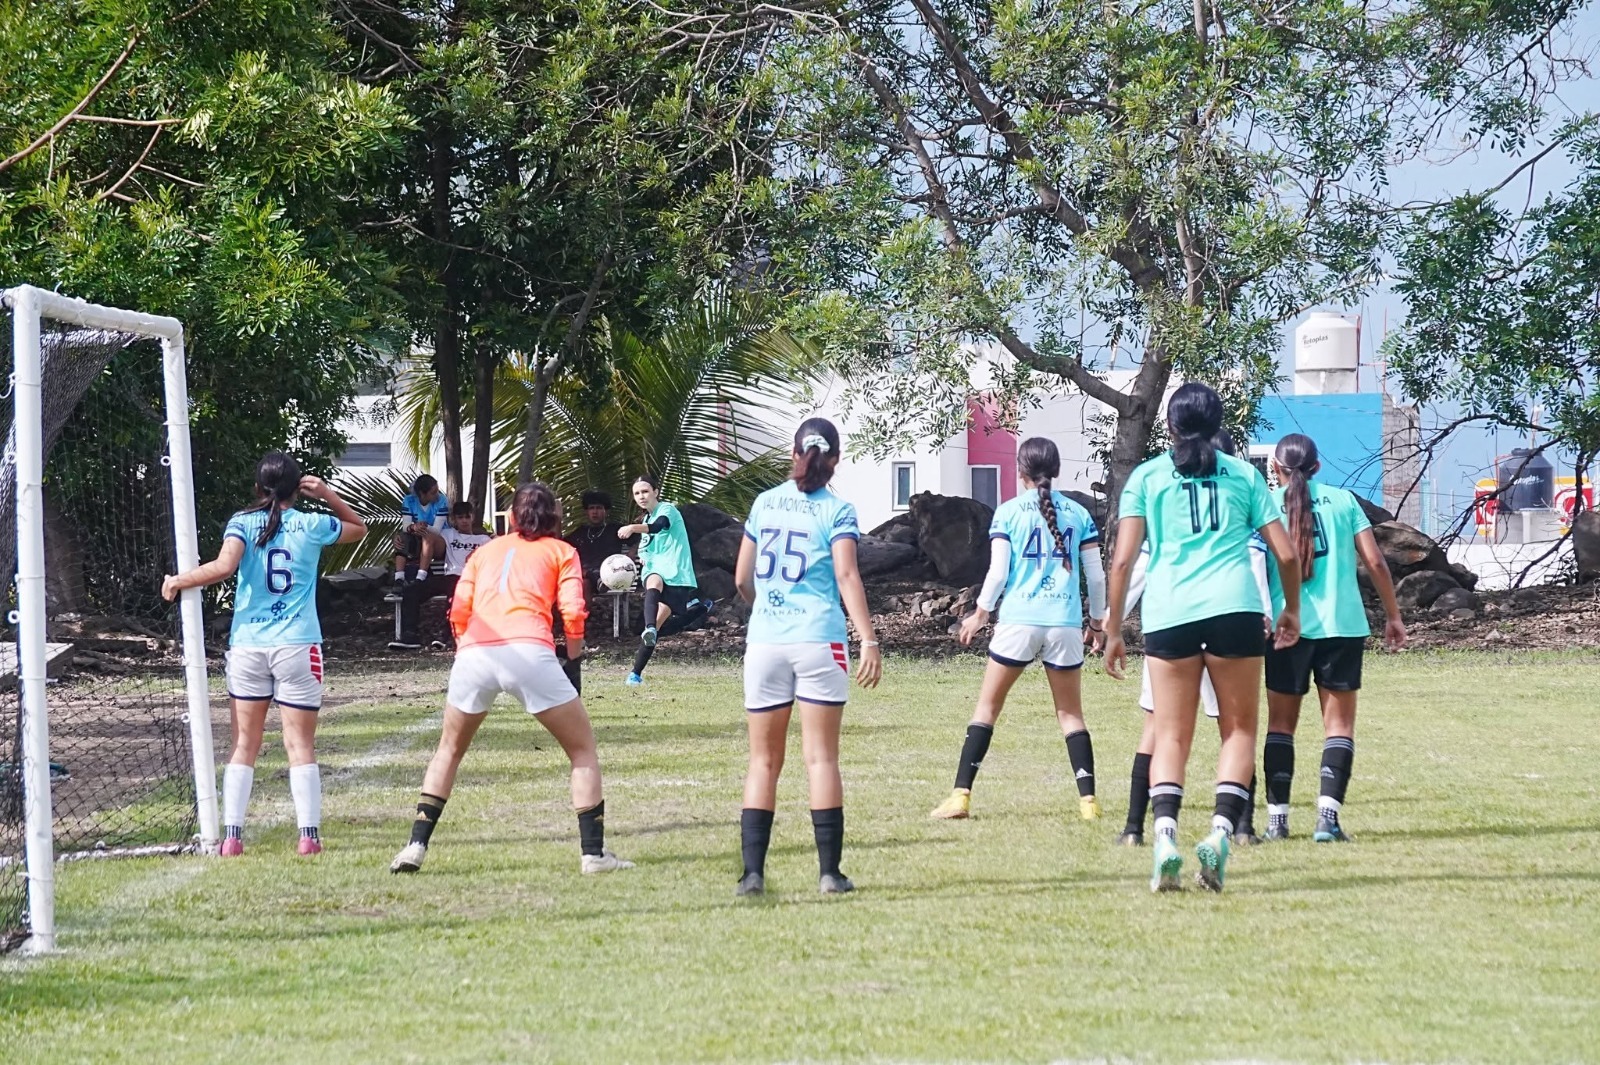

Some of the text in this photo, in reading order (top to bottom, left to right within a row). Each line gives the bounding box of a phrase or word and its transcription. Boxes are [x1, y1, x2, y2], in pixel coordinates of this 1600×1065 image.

[777, 498, 822, 517] MONTERO
[1181, 480, 1220, 534] 11
[499, 547, 517, 593] 1
[755, 526, 810, 585] 35
[1020, 525, 1076, 570] 44
[265, 547, 294, 597] 6
